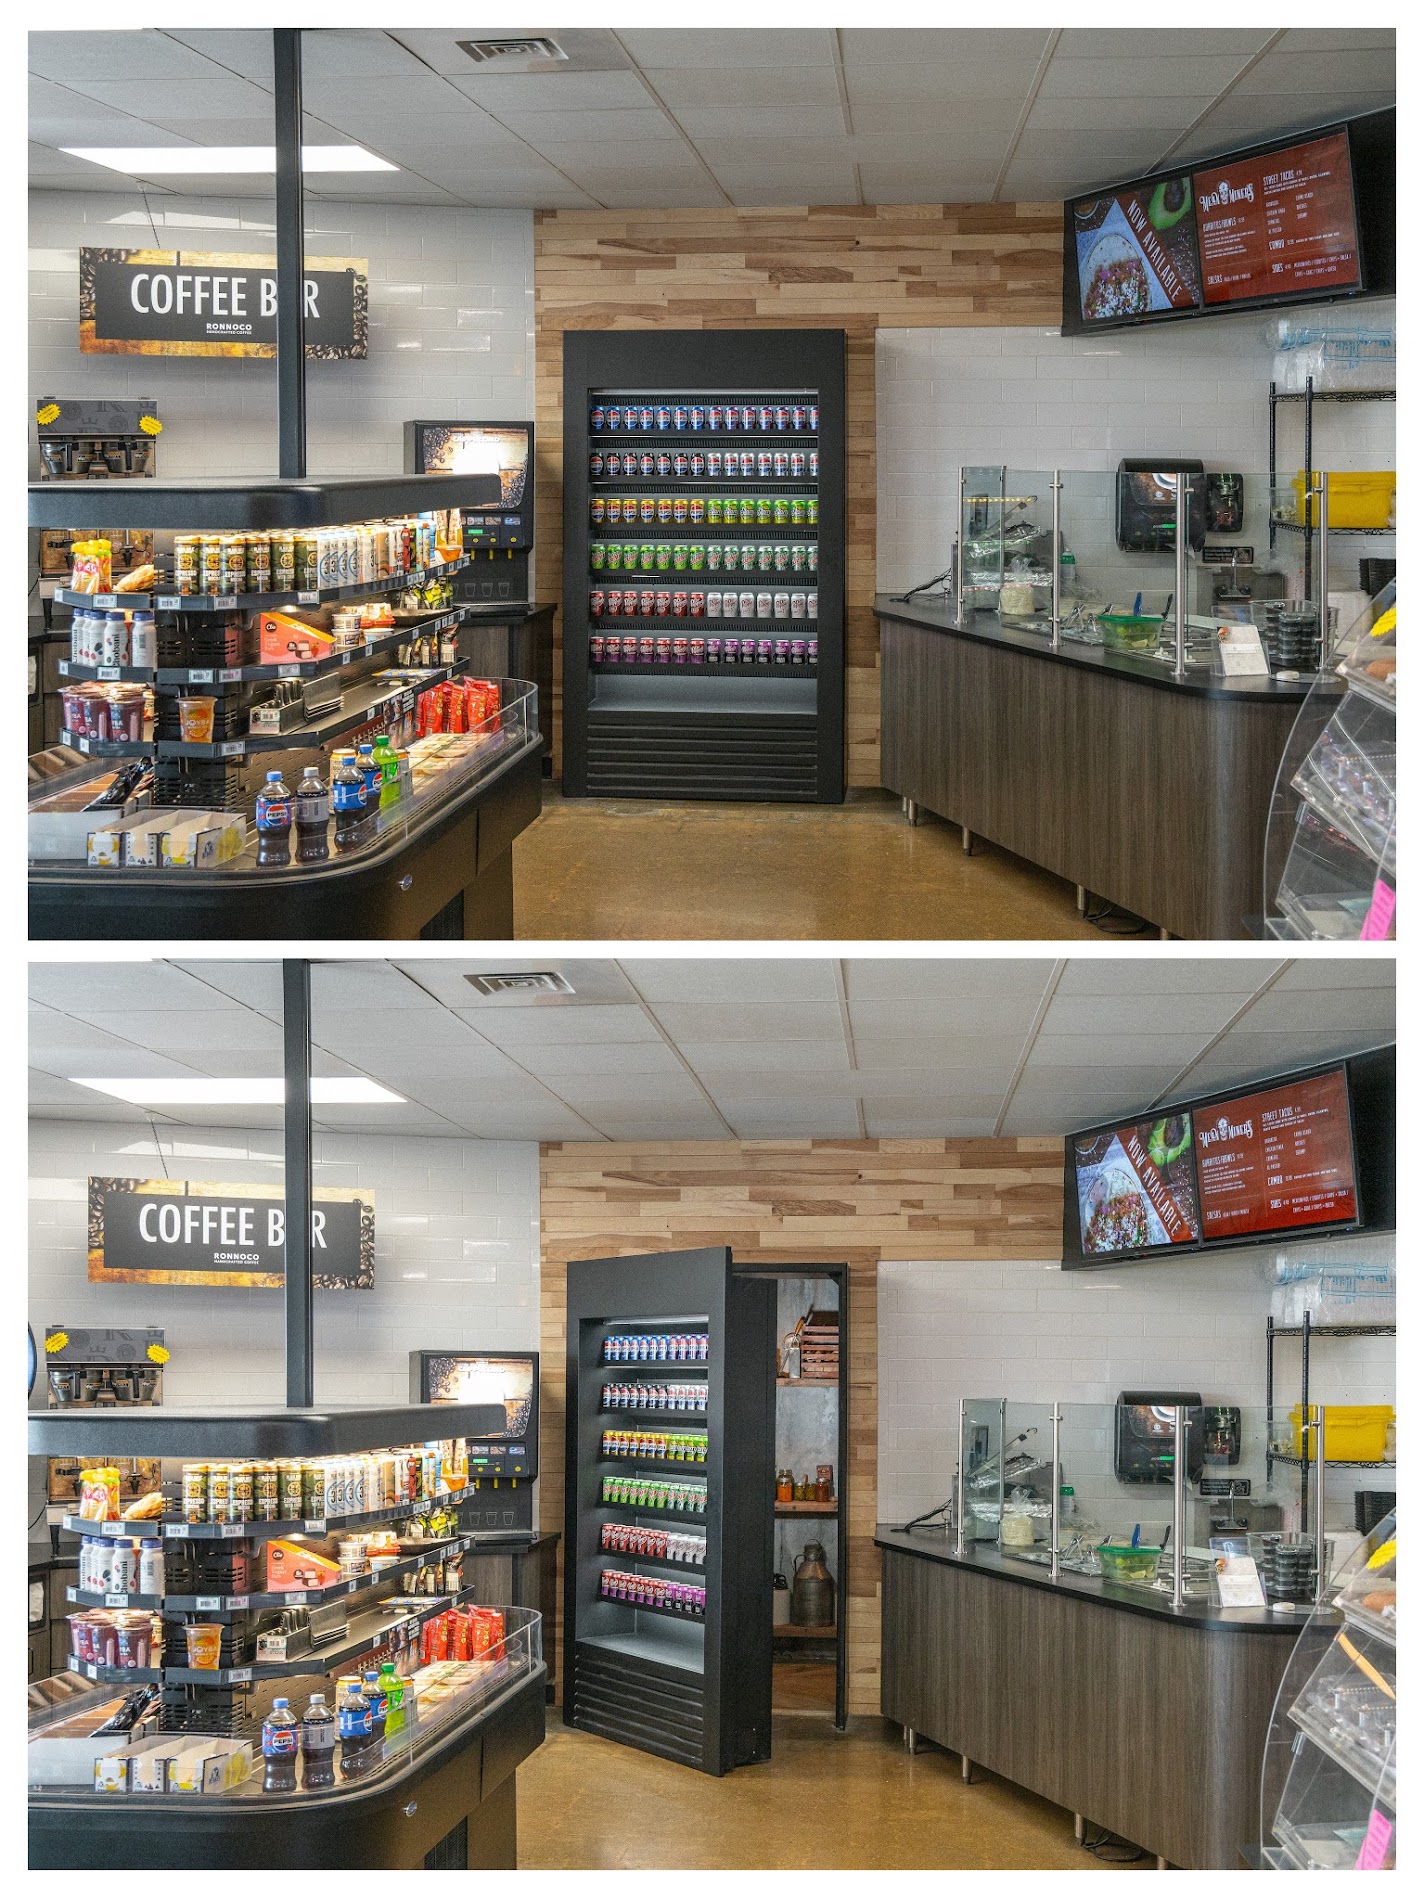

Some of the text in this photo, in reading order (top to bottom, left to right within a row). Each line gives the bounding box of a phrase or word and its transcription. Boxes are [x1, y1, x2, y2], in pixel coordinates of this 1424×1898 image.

[1127, 200, 1182, 301] NOW AVAILABLE
[131, 273, 320, 318] COFFEE BR
[206, 322, 252, 331] RONNOCO
[1127, 1135, 1181, 1236] NOW AVAILABLE
[139, 1203, 327, 1248] COFFEE BR
[213, 1252, 260, 1261] RONNOCO
[273, 1737, 293, 1745] PEPSI
